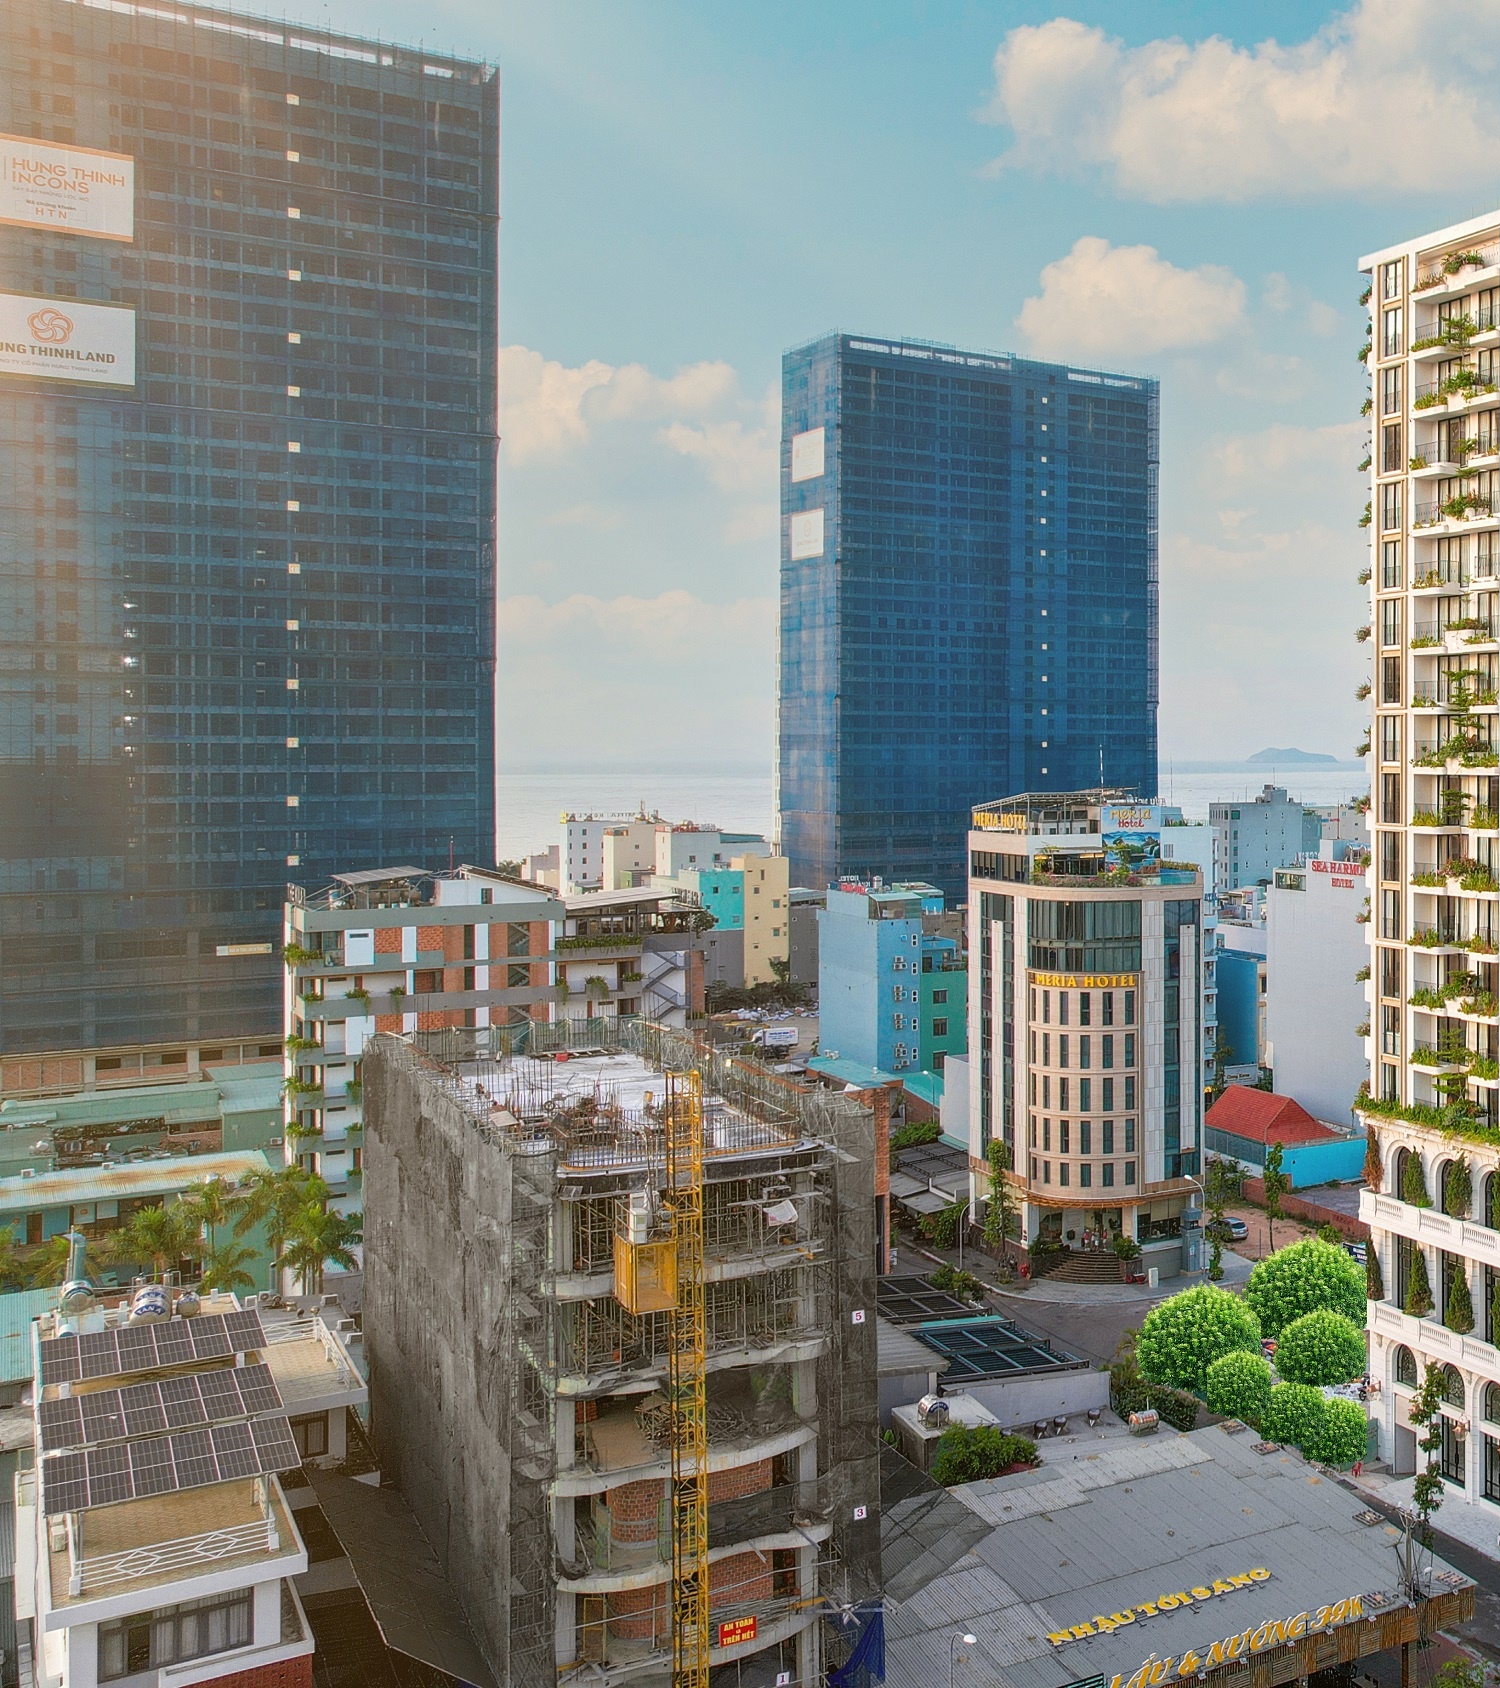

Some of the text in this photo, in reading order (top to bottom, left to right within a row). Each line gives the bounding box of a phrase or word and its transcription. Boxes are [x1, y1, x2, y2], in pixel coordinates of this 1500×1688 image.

[12, 157, 125, 187] HUNG THINH
[12, 171, 90, 194] INCONS
[0, 341, 26, 354] NG
[974, 812, 1027, 830] MERIA HOTEL
[1312, 861, 1327, 873] SEA
[1036, 974, 1136, 988] MERIA HOTEL
[855, 1312, 862, 1321] 5
[857, 1508, 864, 1517] 3
[1046, 1567, 1271, 1646] NHẬU TỚI SÁNG
[724, 1622, 734, 1631] AN
[1205, 1611, 1310, 1667] NƯỚNG
[1310, 1594, 1364, 1629] 39K
[780, 1674, 785, 1683] 1
